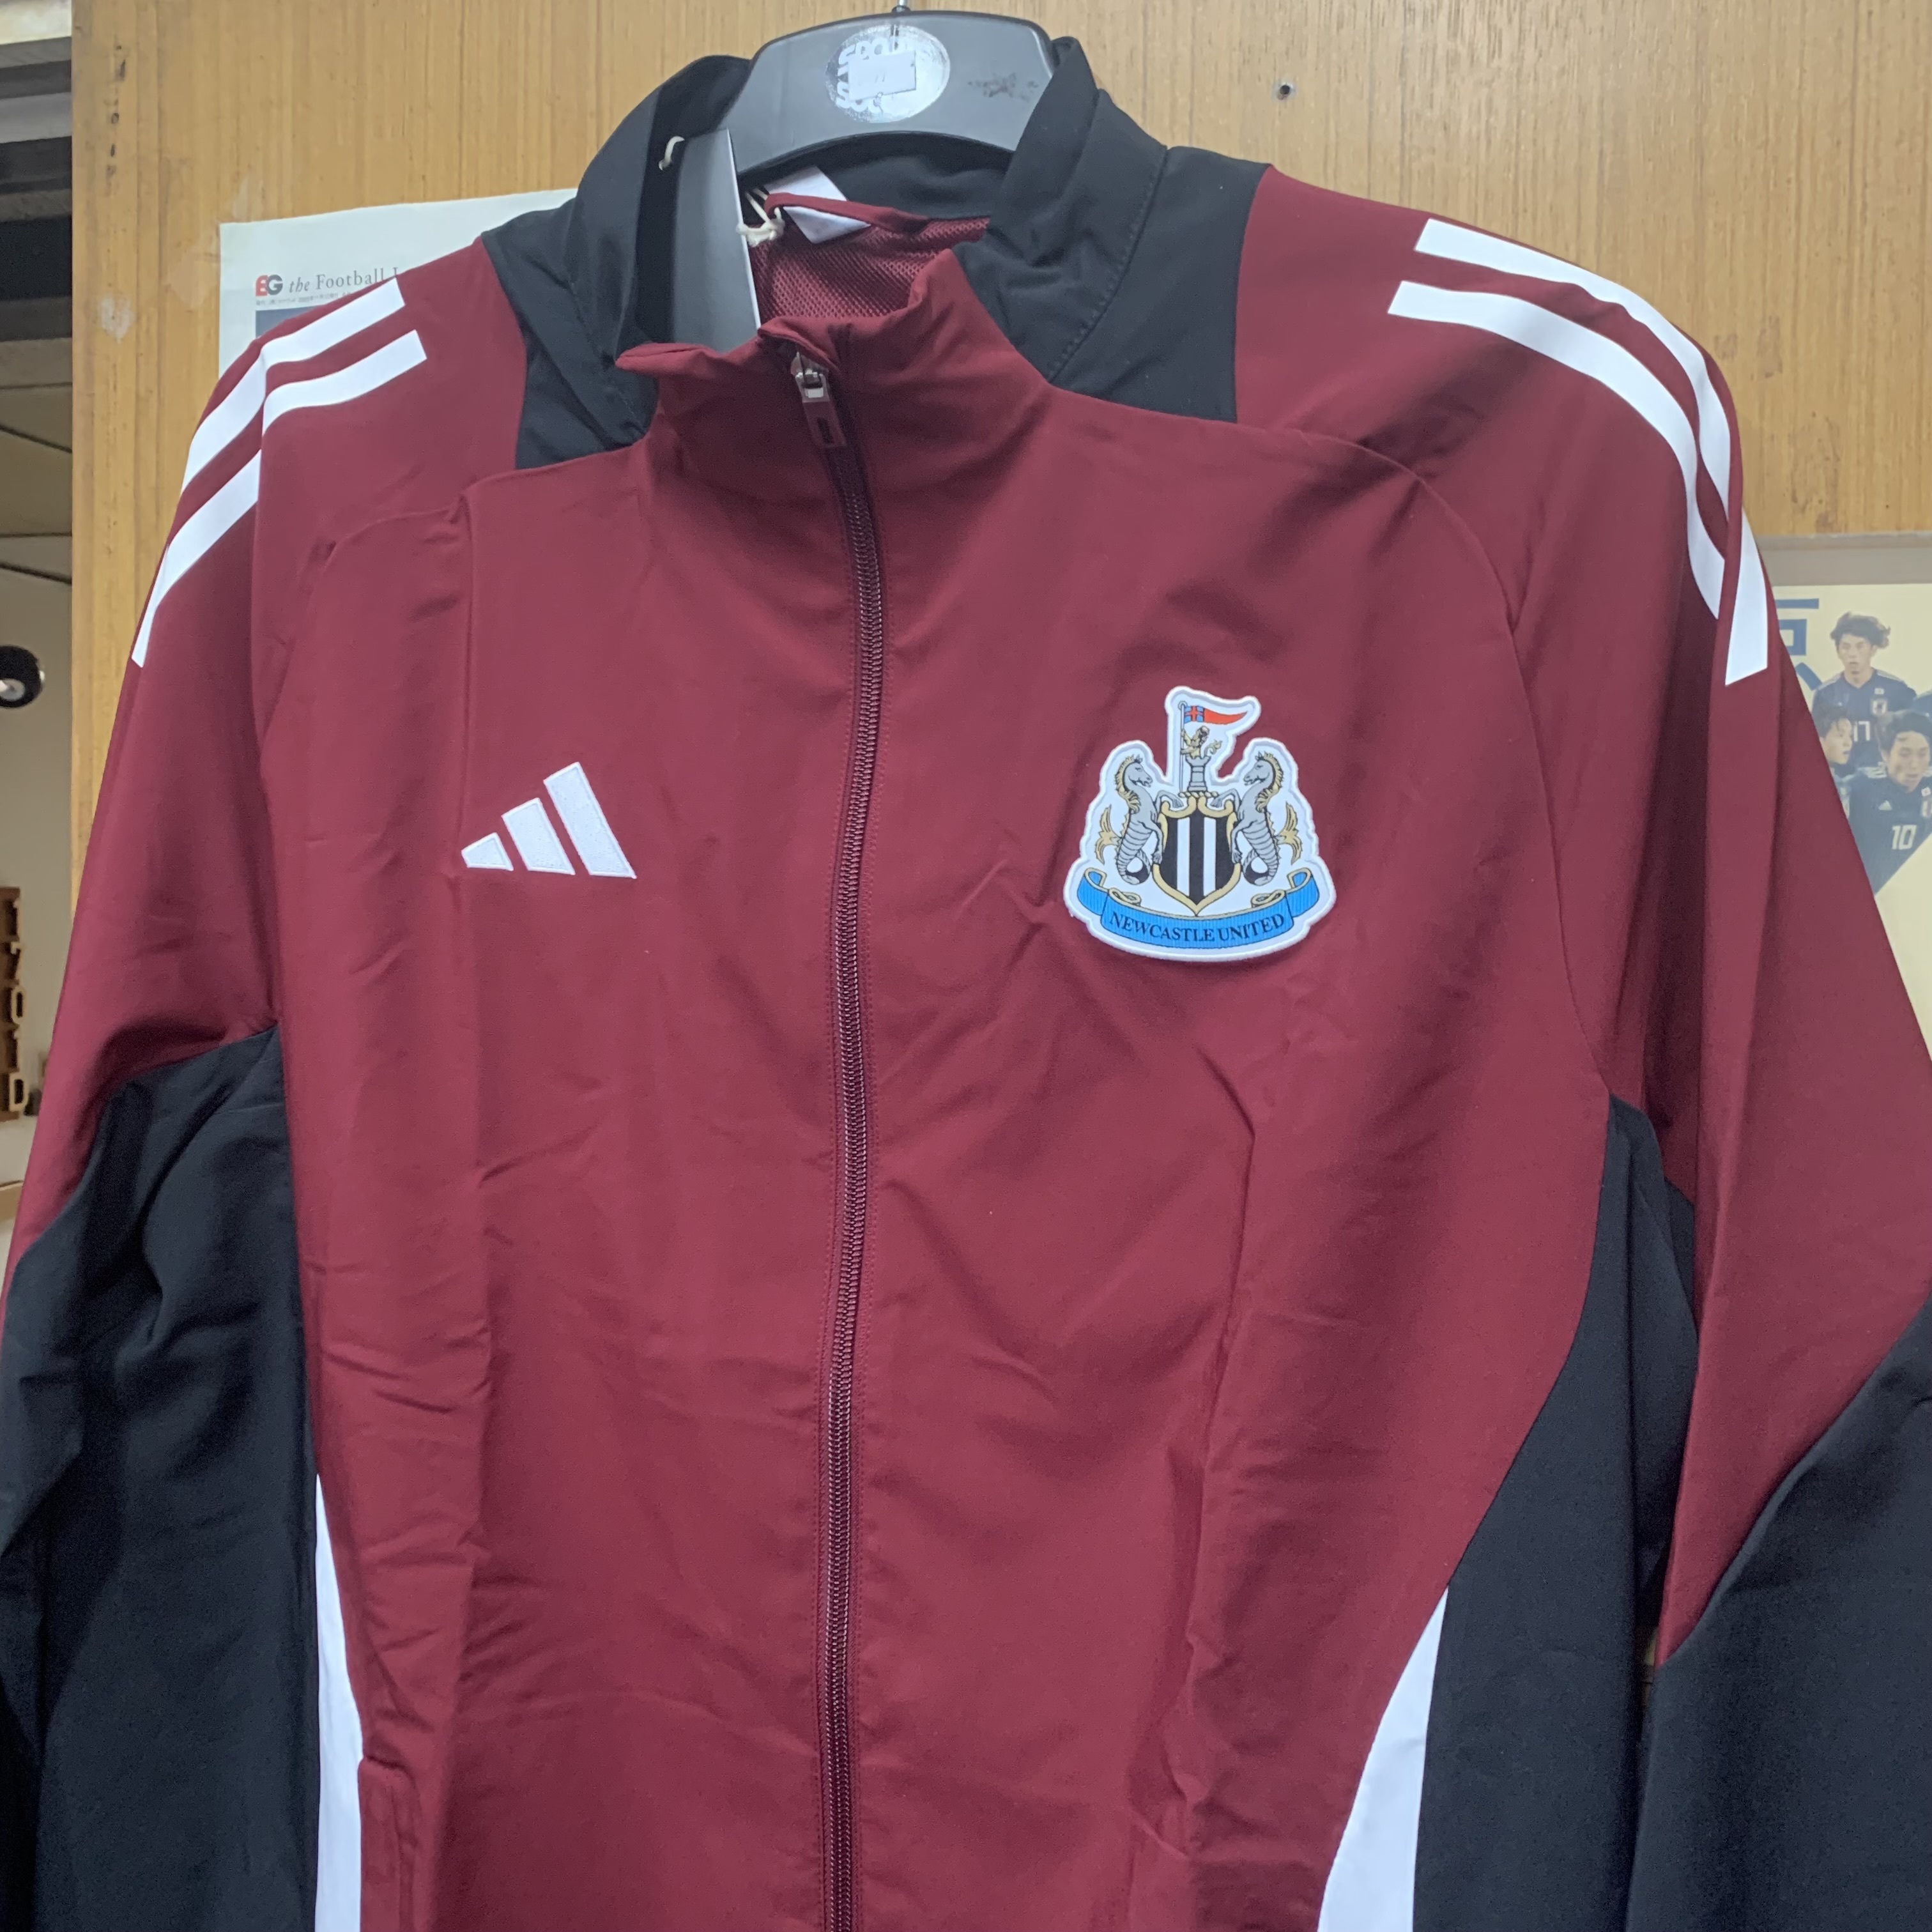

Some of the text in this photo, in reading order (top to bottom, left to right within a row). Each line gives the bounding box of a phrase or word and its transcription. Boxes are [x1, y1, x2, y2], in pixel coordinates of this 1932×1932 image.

[289, 277, 310, 293] the
[316, 268, 384, 290] Football
[1892, 824, 1917, 850] 10
[1108, 911, 1285, 942] NEWCASTLE UNITED
